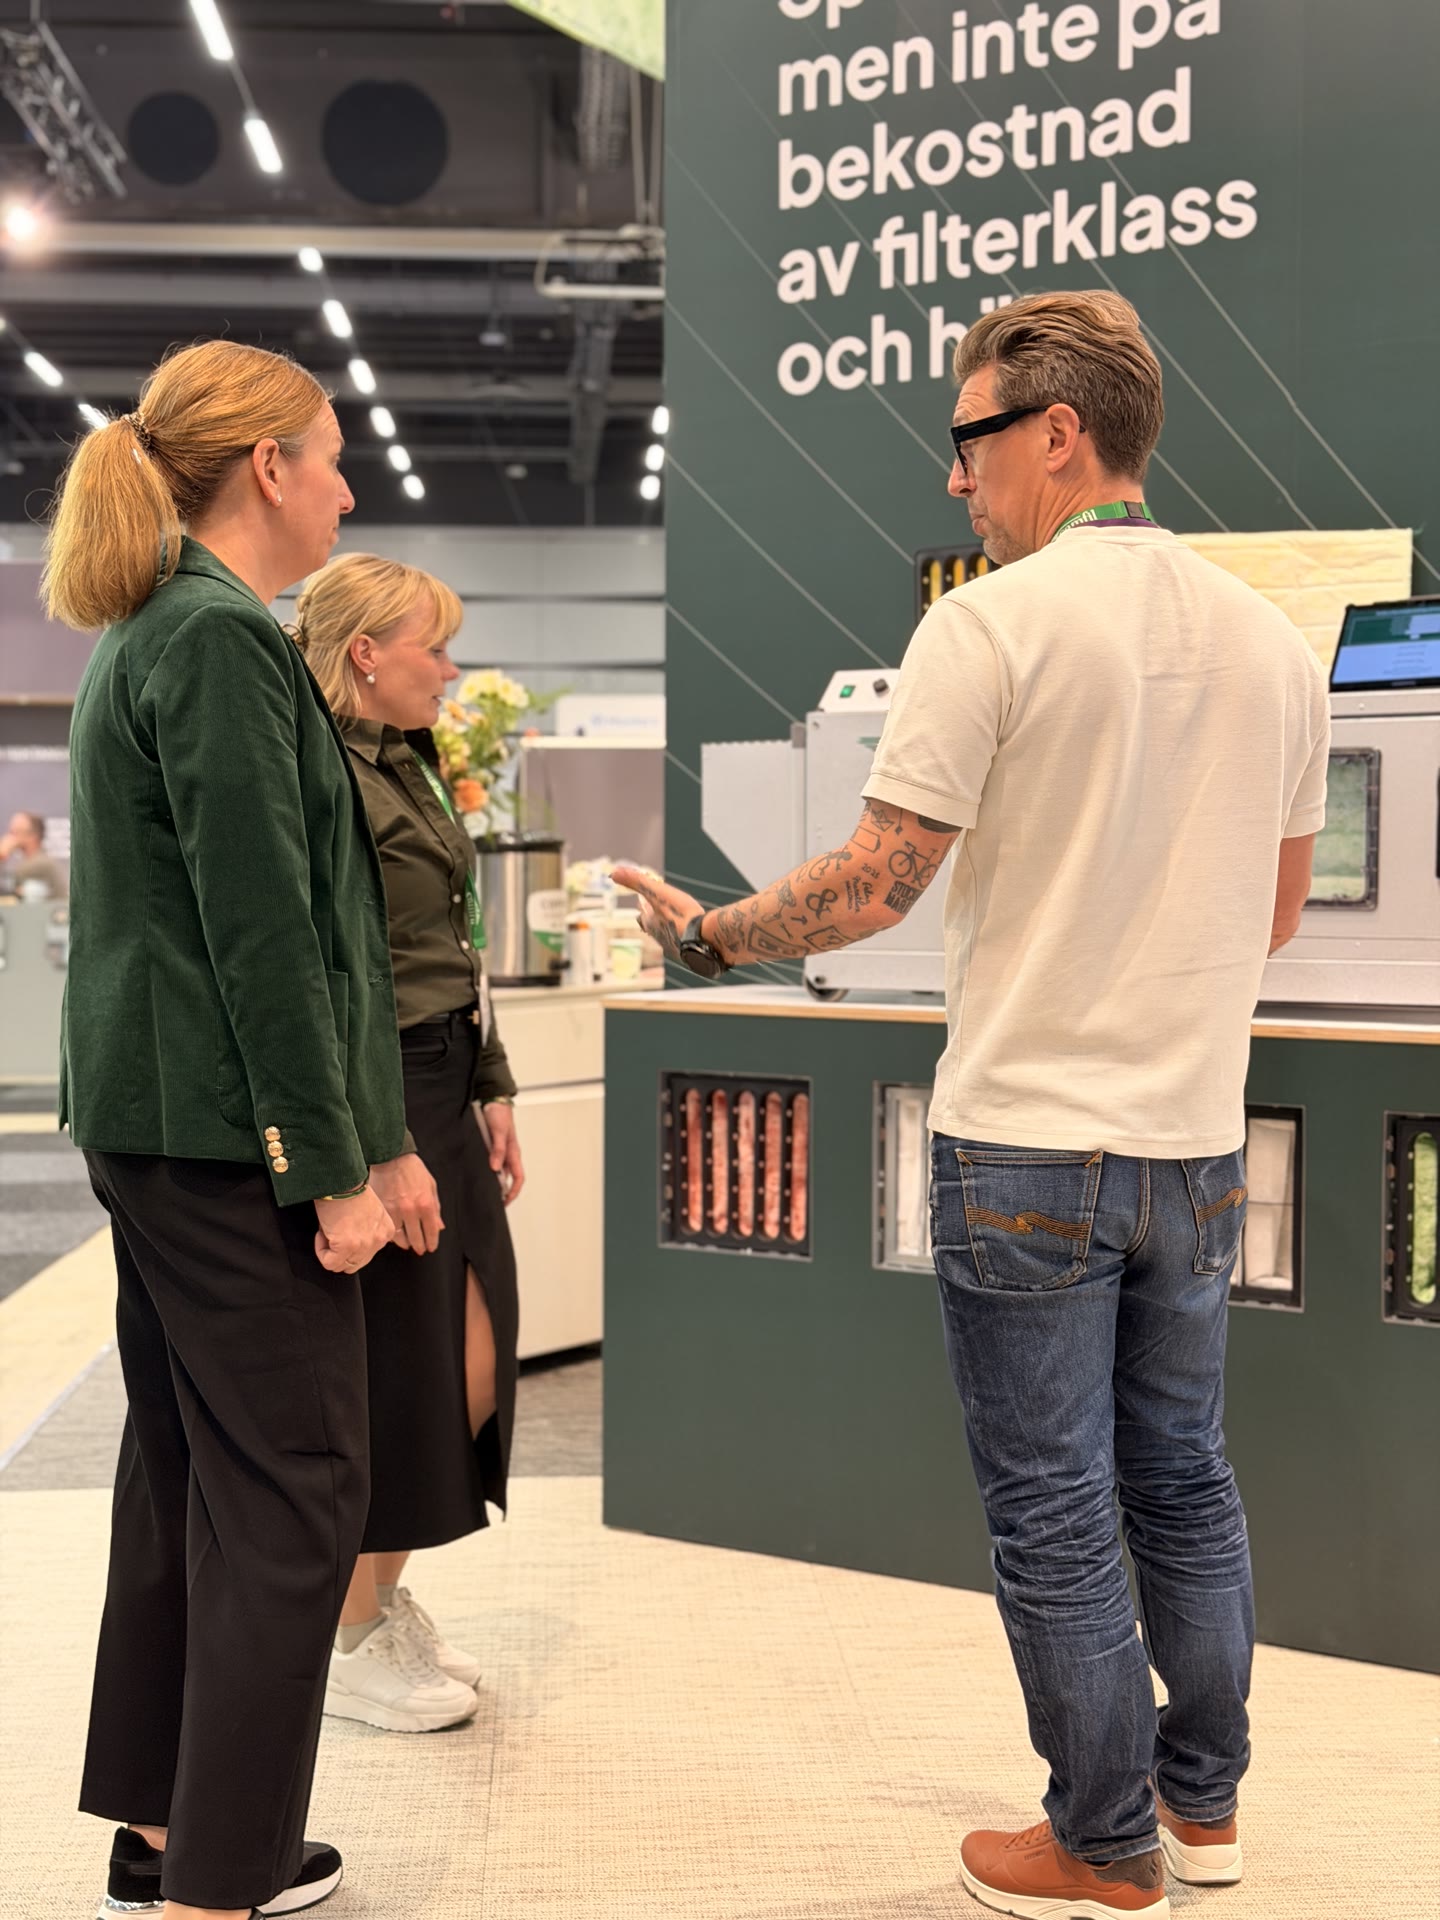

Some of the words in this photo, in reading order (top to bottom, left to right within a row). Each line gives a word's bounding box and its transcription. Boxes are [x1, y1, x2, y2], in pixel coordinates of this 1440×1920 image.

[778, 36, 935, 117] men
[952, 3, 1100, 84] inte
[778, 65, 1192, 211] bekostnad
[776, 241, 861, 304] av
[872, 179, 1258, 291] filterklass
[777, 313, 913, 397] och
